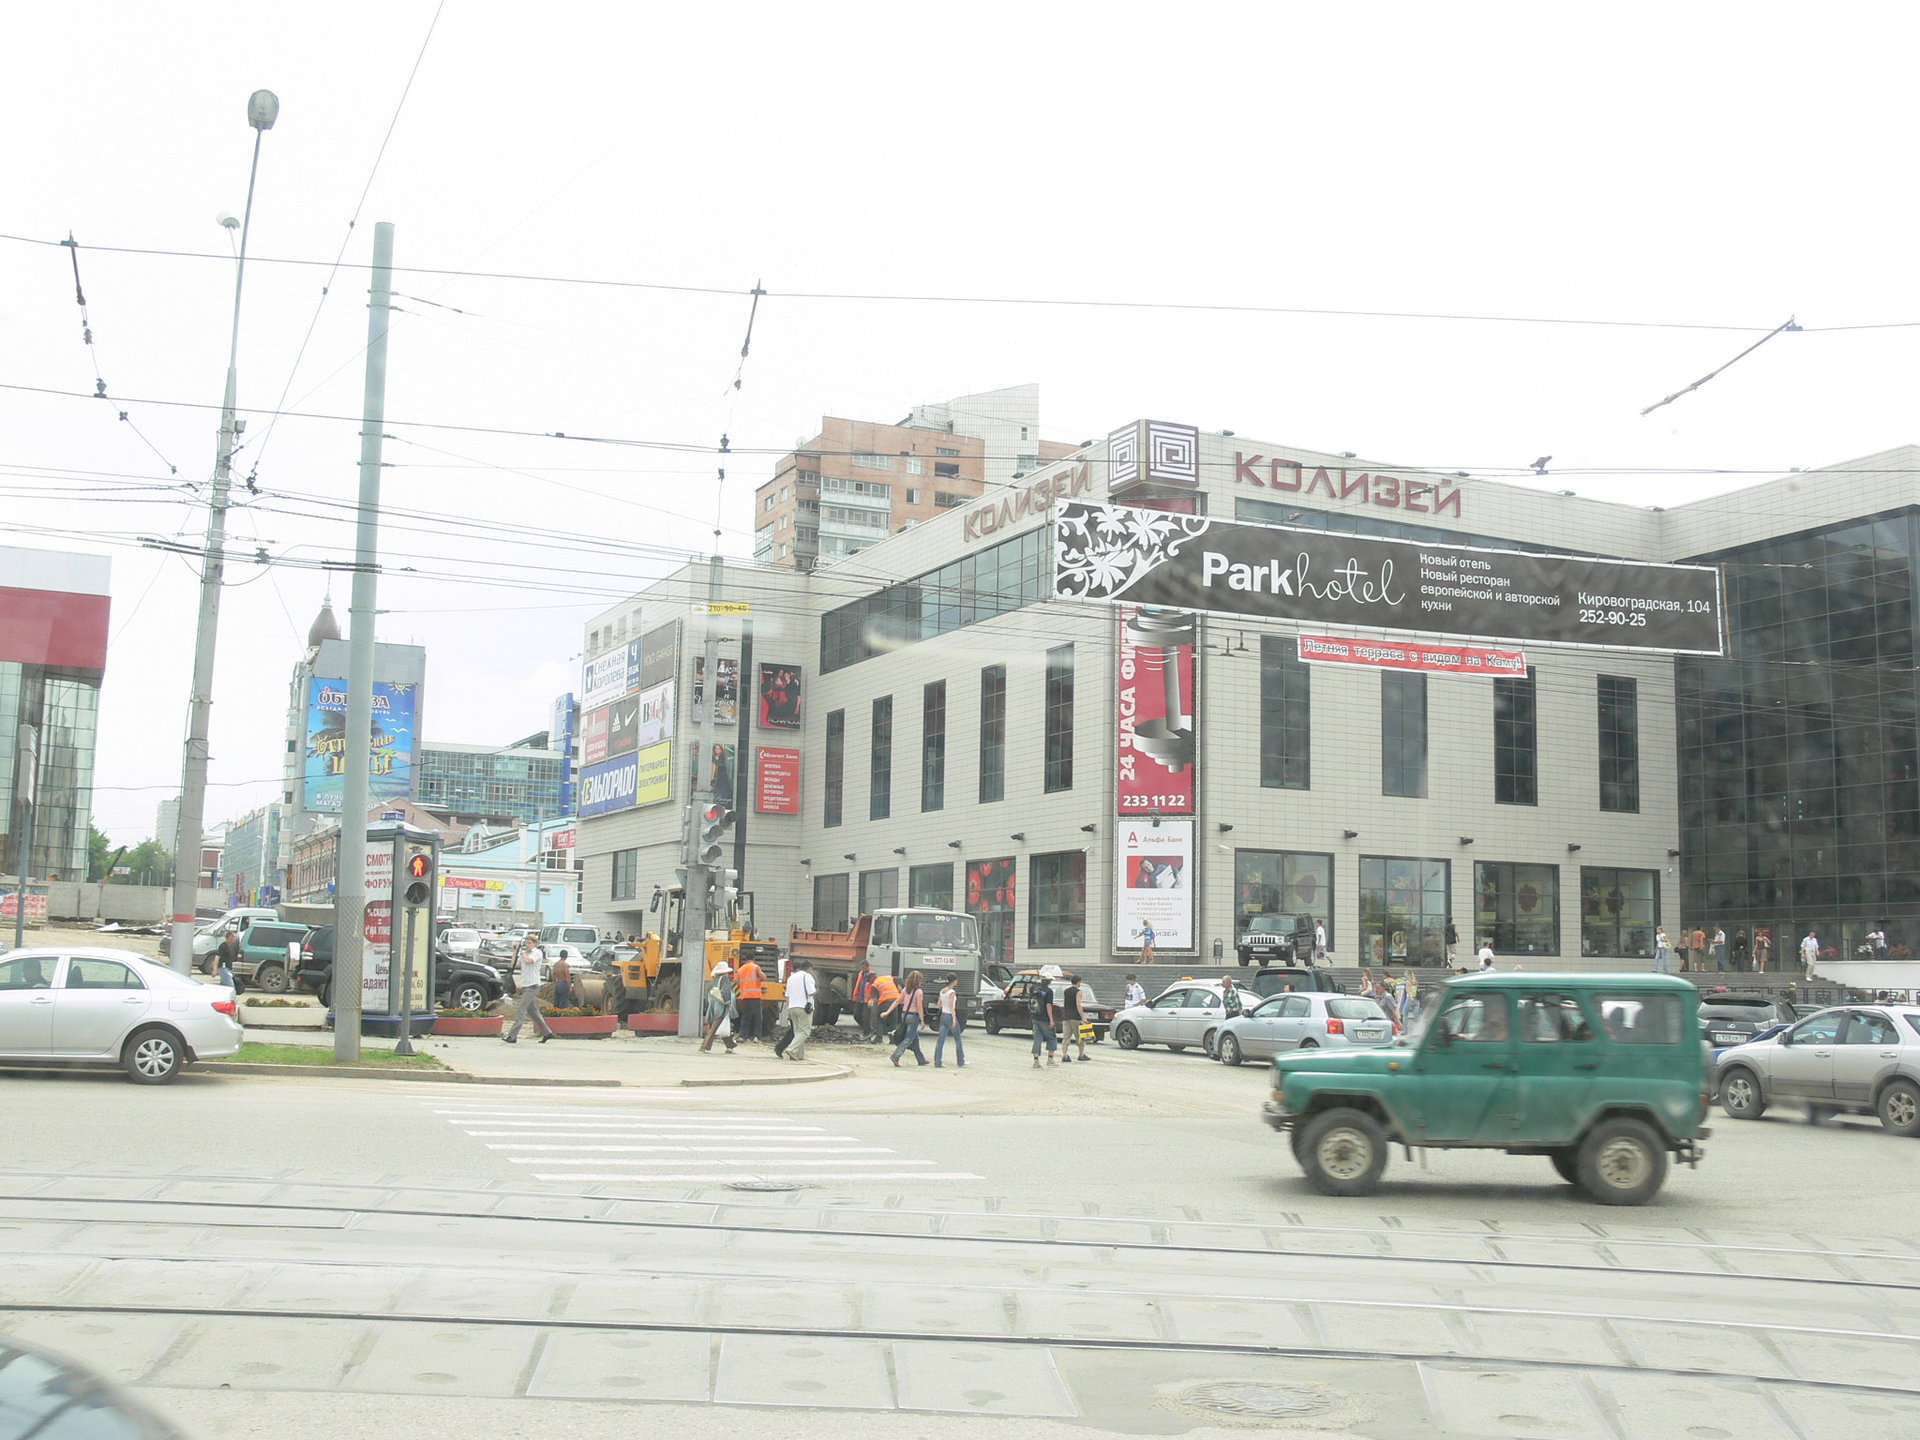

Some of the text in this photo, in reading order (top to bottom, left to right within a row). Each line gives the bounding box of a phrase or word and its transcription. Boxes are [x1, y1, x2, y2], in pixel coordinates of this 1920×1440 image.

[1235, 451, 1461, 518] КОЛИЗЕЙ
[963, 454, 1092, 542] КОЛИЗЕЙ
[1420, 553, 1492, 571] Новый отель
[1203, 551, 1406, 606] Parkhotel
[1420, 568, 1510, 588] Новый ресторан
[1420, 584, 1560, 606] европейской и авторской
[1421, 600, 1452, 611] кухни
[1578, 592, 1711, 614] Кировоградская, 104
[1579, 609, 1646, 627] 252-90-25
[594, 651, 625, 675] Снежная
[1304, 639, 1522, 671] Летняя терраса с видом на Каму!
[593, 667, 625, 691] Королева
[1120, 687, 1136, 747] ЧАСА
[1120, 755, 1135, 780] 24
[1122, 795, 1149, 807] 233
